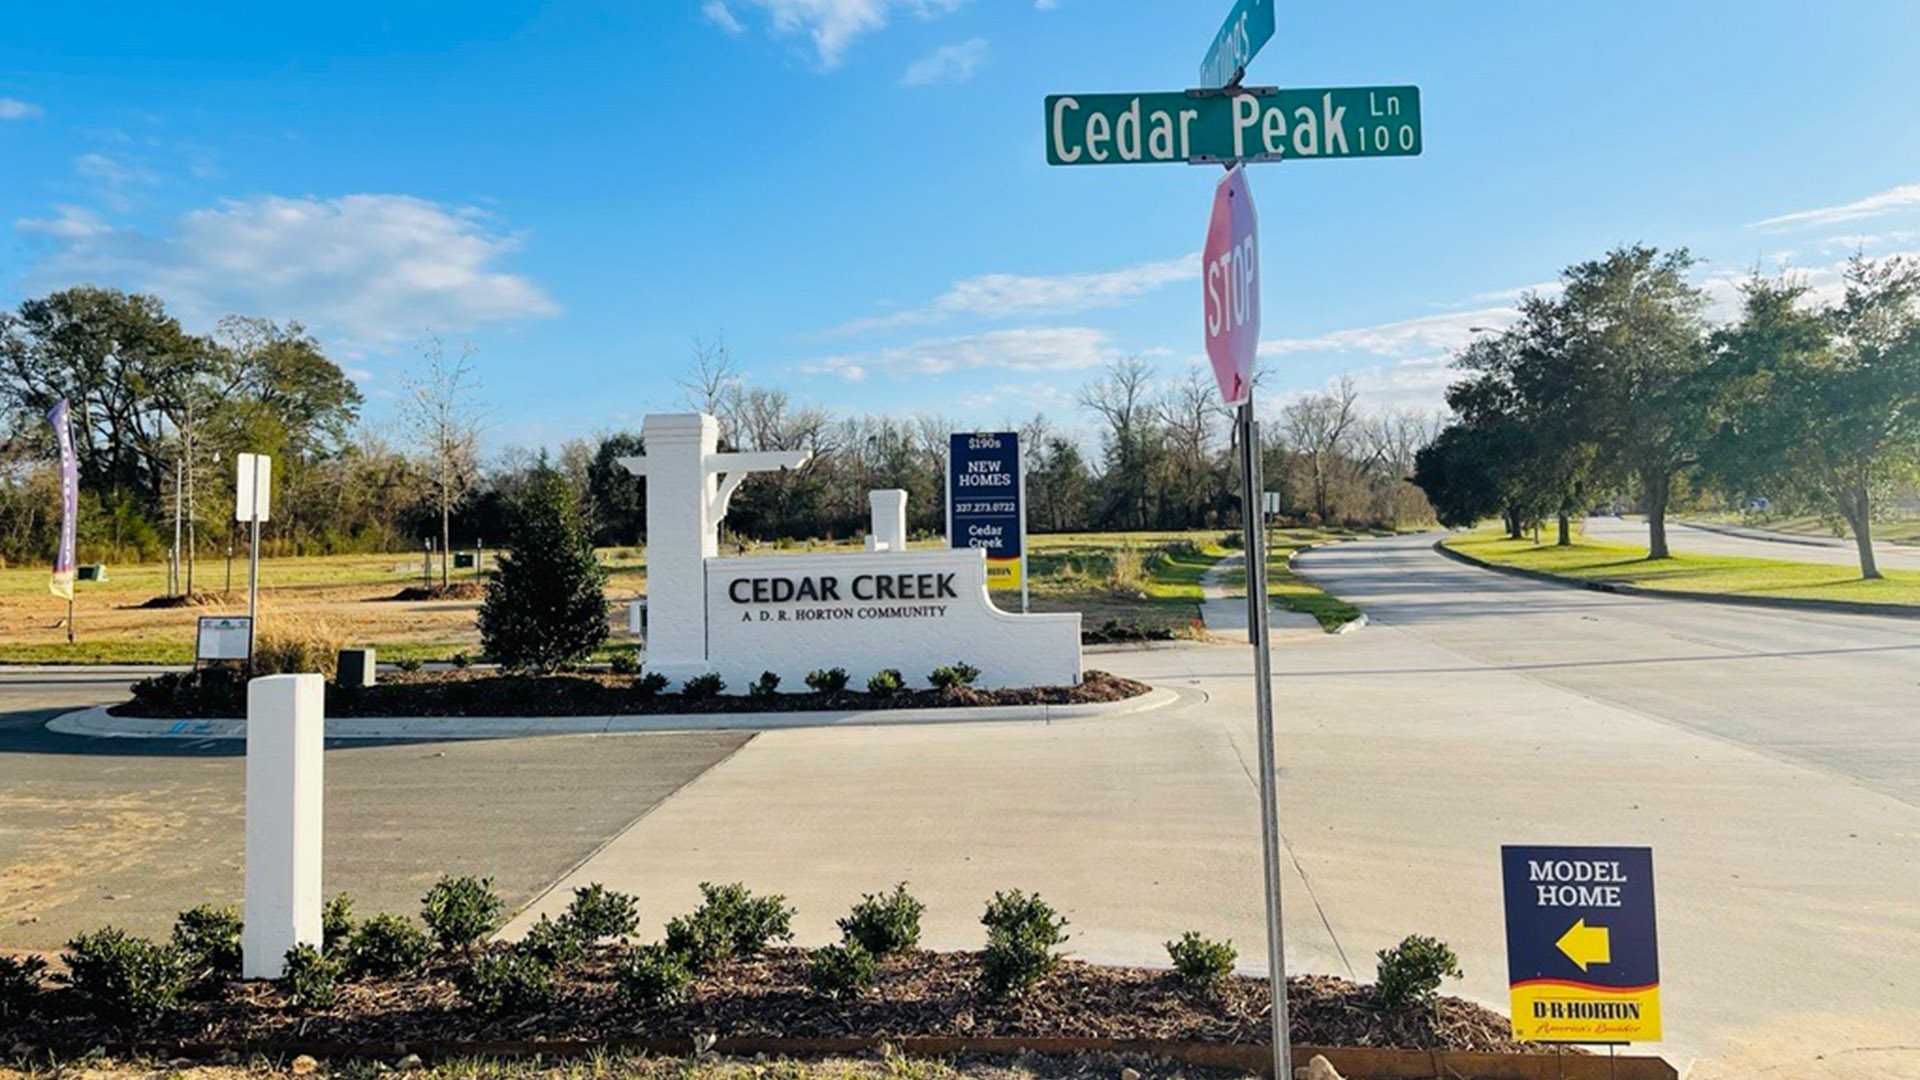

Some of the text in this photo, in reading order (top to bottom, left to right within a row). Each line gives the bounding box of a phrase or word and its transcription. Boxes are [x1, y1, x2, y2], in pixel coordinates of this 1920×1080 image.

[1370, 92, 1399, 116] Ln
[1054, 93, 1350, 162] Cedar Peak
[1358, 125, 1414, 151] 100
[1208, 234, 1254, 337] STOP
[968, 460, 1001, 473] NEW
[959, 473, 1011, 486] HOMES
[968, 525, 1003, 536] Cedar
[968, 537, 1003, 549] Creek
[728, 573, 957, 604] CEDAR CREEK
[742, 605, 947, 622] A D. R. HORTON COMMUNITY
[1528, 861, 1627, 882] MODEL
[1537, 885, 1621, 906] HOME
[1594, 1021, 1641, 1034] Builder
